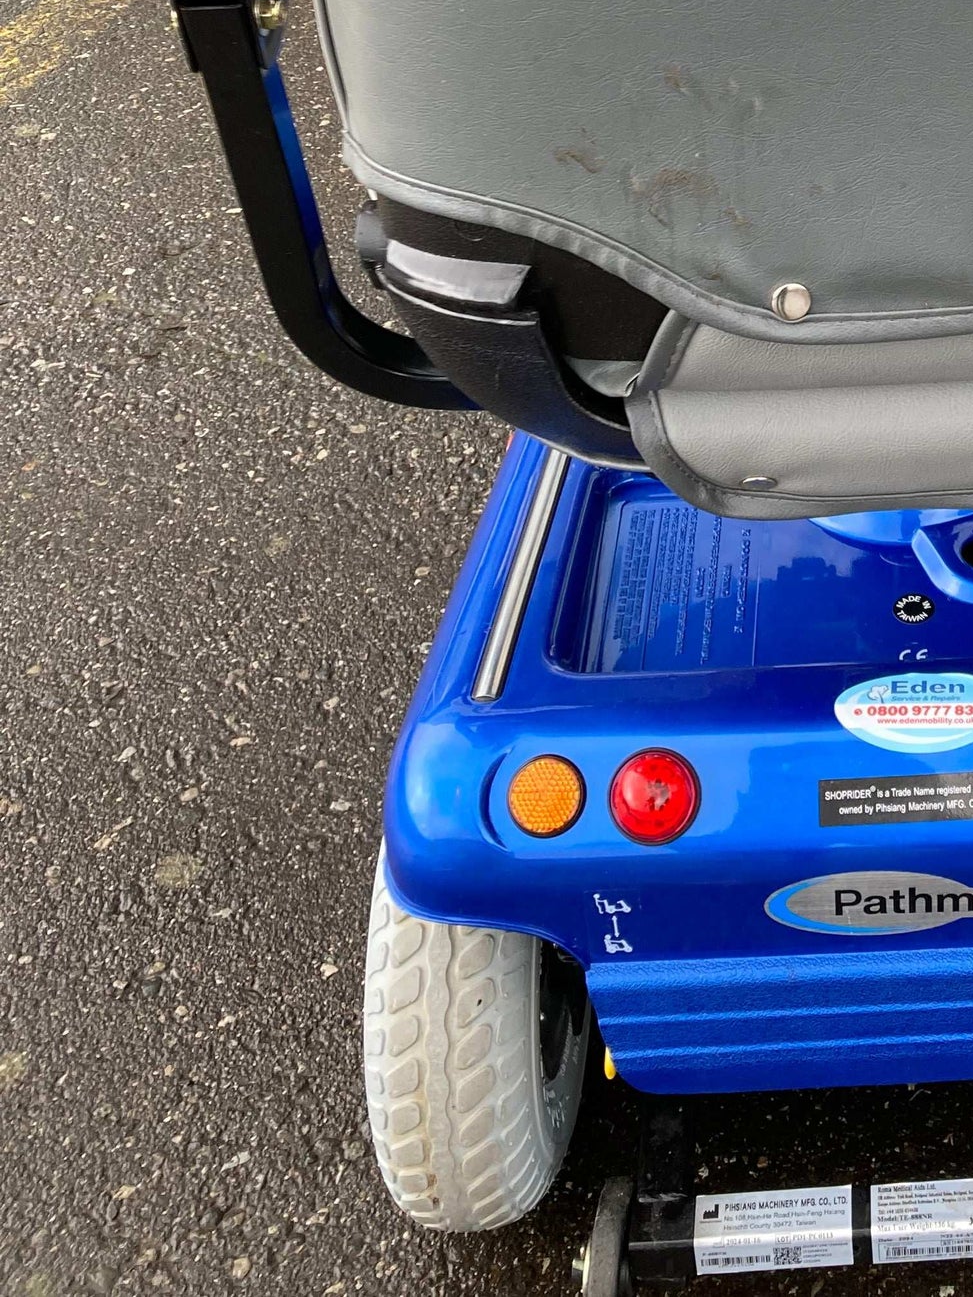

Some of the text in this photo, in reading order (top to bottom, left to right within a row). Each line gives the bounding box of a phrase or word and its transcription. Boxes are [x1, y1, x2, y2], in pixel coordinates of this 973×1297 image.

[896, 595, 922, 609] MADE
[897, 610, 929, 622] TAIWAN
[891, 680, 965, 694] Eden
[867, 705, 909, 716] 0800
[912, 705, 952, 716] 9777
[877, 788, 884, 798] is
[891, 787, 912, 797] Trade
[914, 786, 935, 796] Name
[936, 784, 972, 796] registered
[839, 805, 863, 815] owned
[864, 804, 874, 816] by
[875, 803, 906, 814] Pihsiang
[908, 801, 945, 813] Machinery
[947, 800, 967, 809] MFG.
[878, 1185, 892, 1193] Roma
[893, 1184, 913, 1192] Medical
[724, 1203, 757, 1212] PIHSIANG
[758, 1200, 798, 1210] MACHINERY
[833, 1196, 848, 1205] LTD.
[749, 1222, 771, 1230] County
